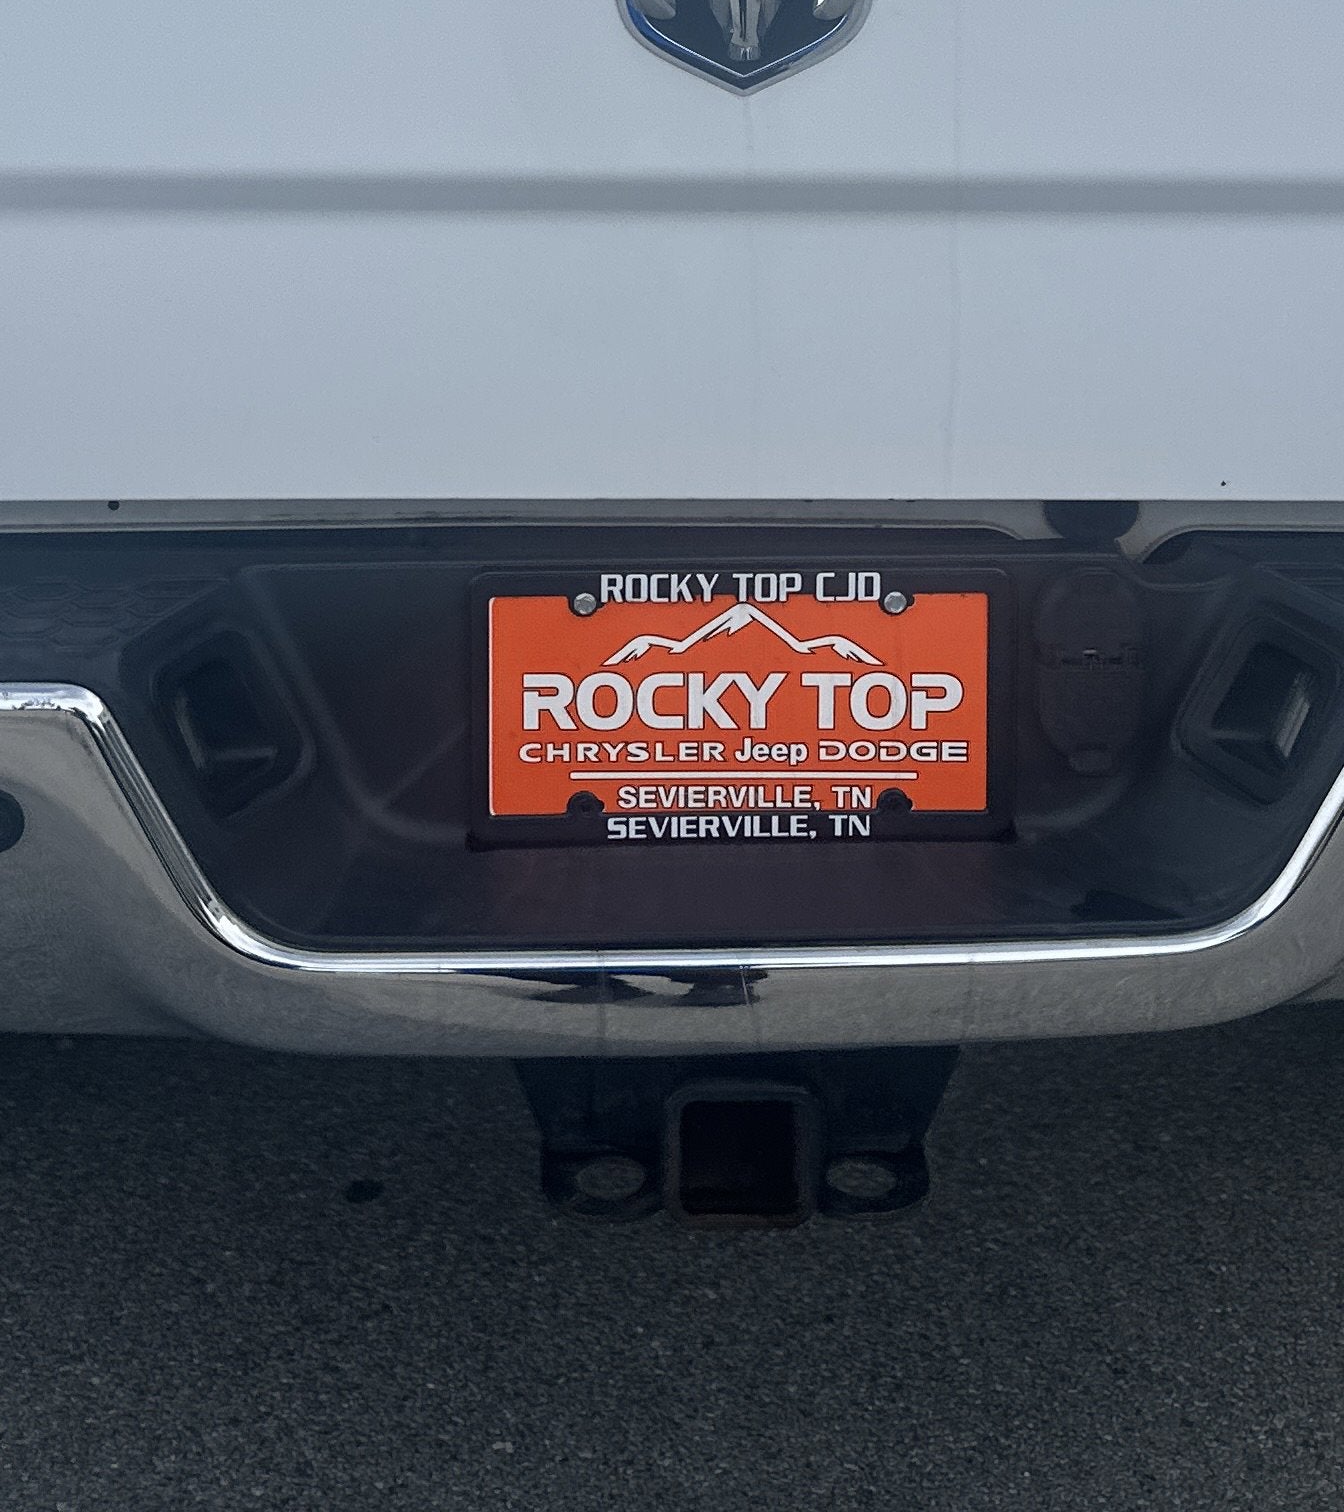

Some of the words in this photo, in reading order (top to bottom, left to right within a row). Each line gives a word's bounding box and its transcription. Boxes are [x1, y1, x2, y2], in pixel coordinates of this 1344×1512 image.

[599, 572, 719, 604] ROCKY
[732, 572, 802, 603] TOP
[815, 571, 881, 603] CJD
[522, 672, 789, 731] ROCKY
[801, 672, 963, 731] TOP
[518, 740, 726, 763] CHRYSLER
[734, 737, 809, 766] Jeep
[818, 740, 968, 762] DODGE
[617, 785, 820, 811] SEVIERVILLE,
[832, 785, 872, 809] TN
[606, 814, 818, 840] SEVIERVILLE,
[829, 814, 871, 837] TN
